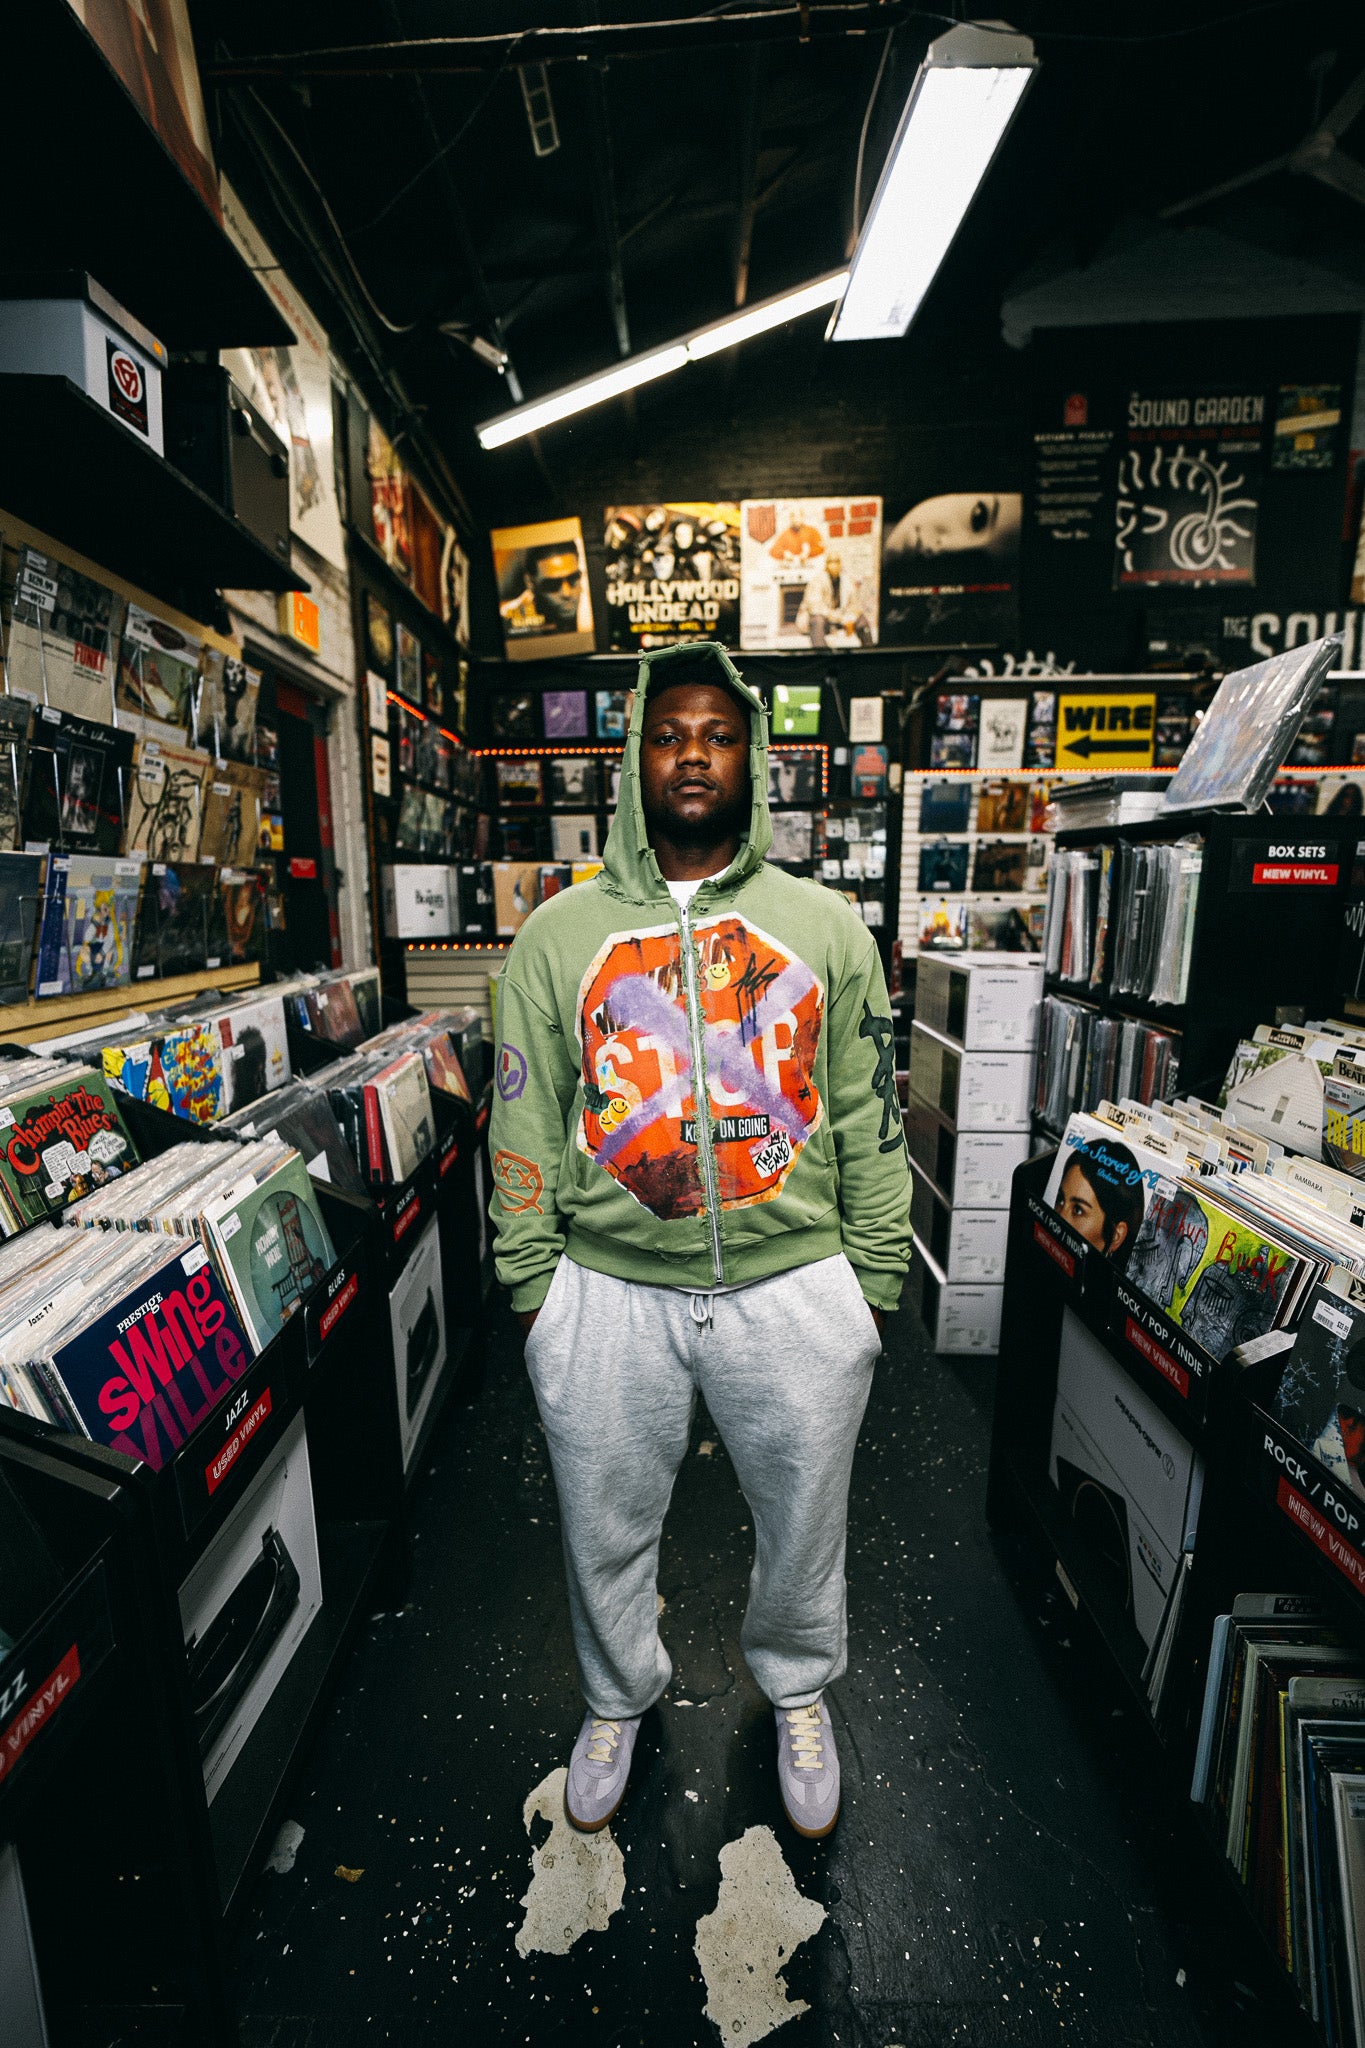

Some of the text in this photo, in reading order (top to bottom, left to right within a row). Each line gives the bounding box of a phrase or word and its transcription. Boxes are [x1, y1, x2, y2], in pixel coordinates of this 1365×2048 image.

[1128, 396, 1264, 427] SOUND GARDEN
[606, 579, 739, 607] HOLLYWOOD
[628, 600, 720, 623] UNDEAD
[1251, 611, 1365, 672] SOU
[1064, 705, 1153, 731] WIRE
[1268, 845, 1326, 859] BOX SETS
[1262, 868, 1329, 881] NEW VINYL
[595, 1010, 799, 1119] STOP
[70, 1085, 105, 1116] The
[719, 1119, 735, 1139] ON
[738, 1117, 768, 1137] GOING
[1297, 1119, 1318, 1132] Anyway
[1325, 1107, 1350, 1151] THE
[1065, 1132, 1090, 1154] The
[1089, 1145, 1130, 1175] Secret
[1125, 1168, 1152, 1187] of
[1294, 1173, 1323, 1193] BAMBARA
[1028, 1197, 1044, 1220] ROCK
[1048, 1217, 1062, 1236] POP
[1066, 1235, 1084, 1259] INDIE
[327, 1268, 346, 1297] BLUES
[322, 1281, 356, 1331] USED VINYL
[1117, 1285, 1141, 1319] ROCK
[1148, 1311, 1169, 1341] POP
[1176, 1342, 1203, 1378] INDIE
[1130, 1328, 1182, 1386] NEW VINYL
[225, 1389, 250, 1431] JAZZ
[212, 1401, 268, 1480] USED VINYL
[1263, 1434, 1359, 1531] ROCK / POP
[1287, 1494, 1326, 1541] NEW
[7, 1673, 71, 1751] VINYL
